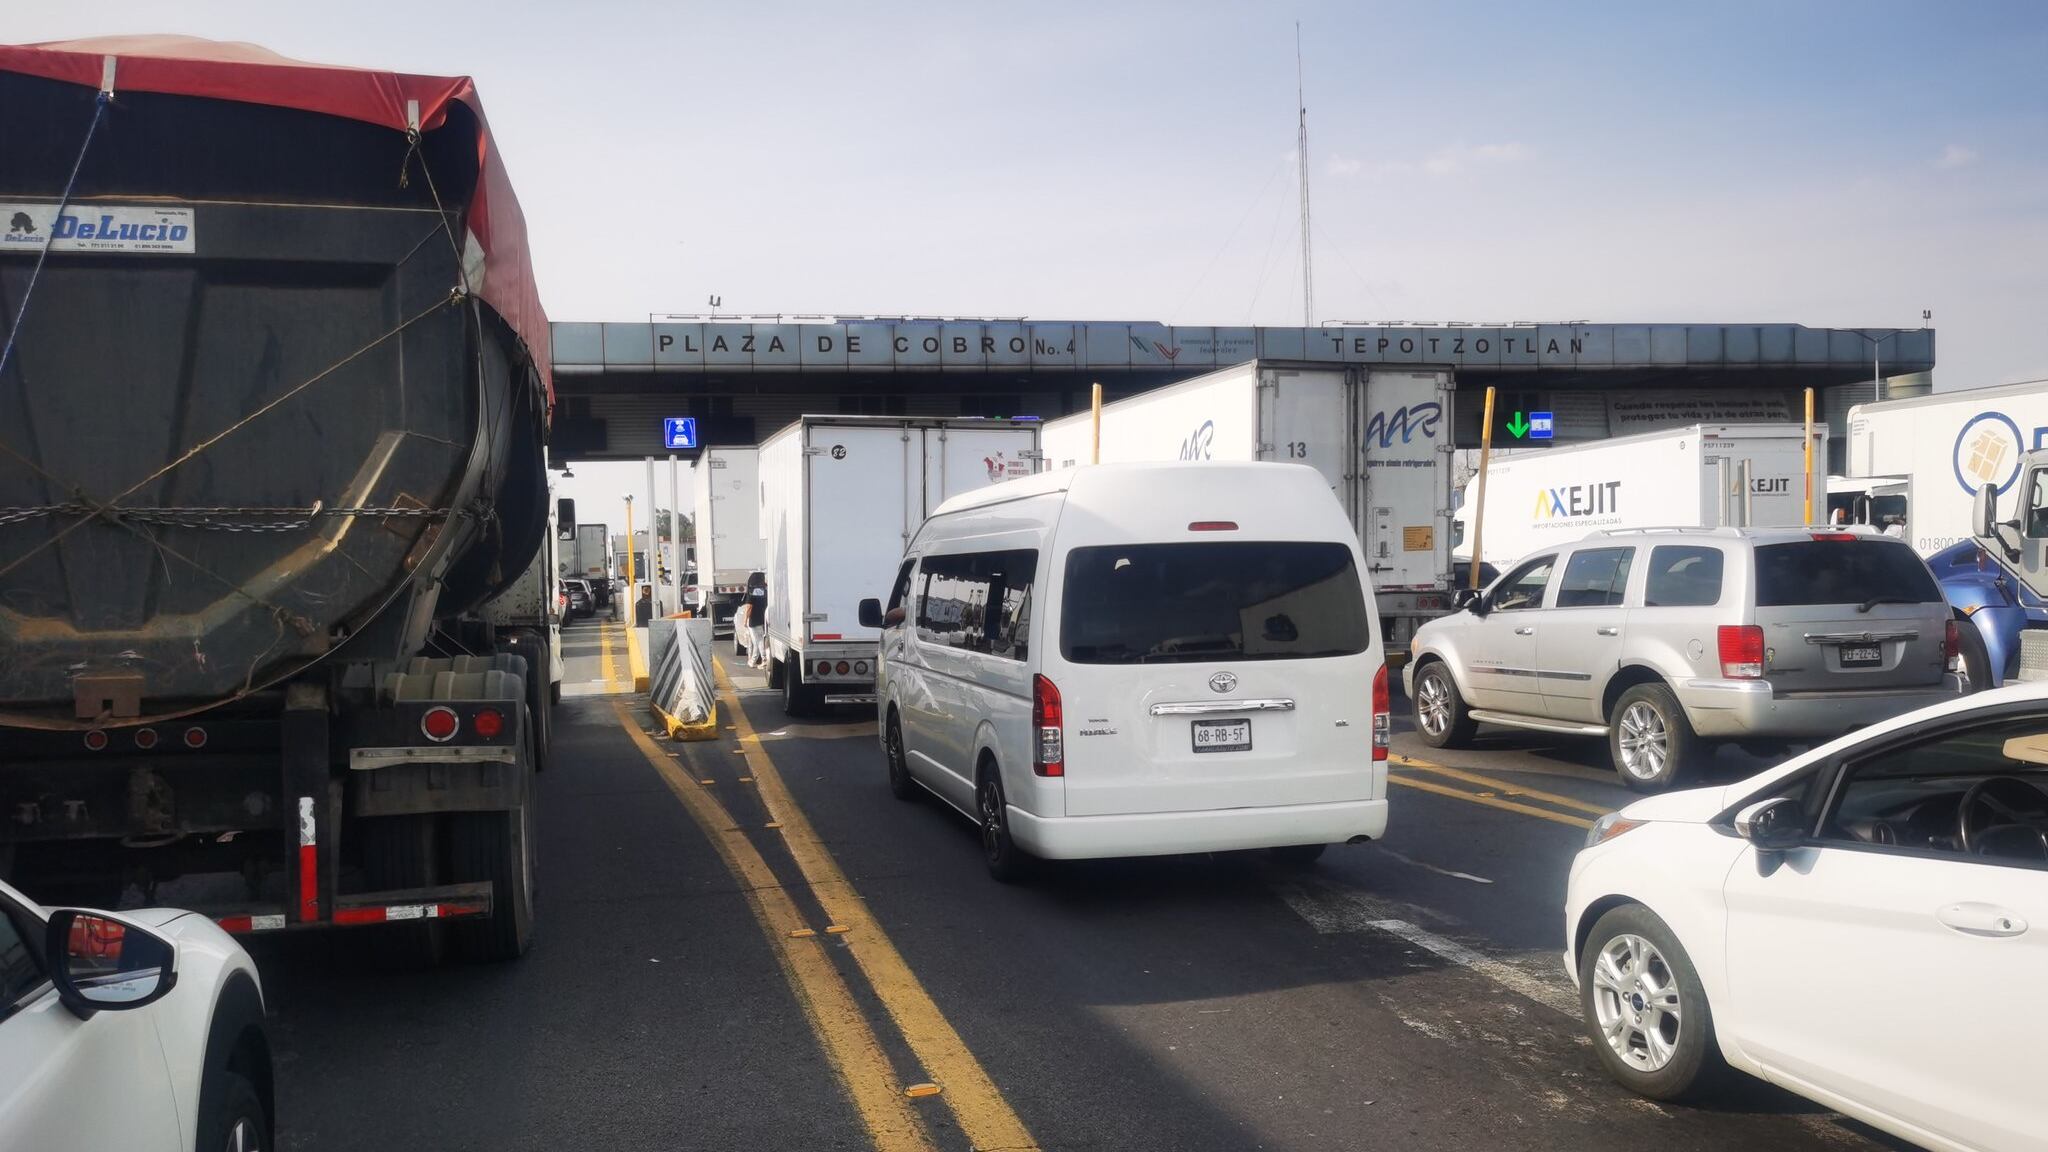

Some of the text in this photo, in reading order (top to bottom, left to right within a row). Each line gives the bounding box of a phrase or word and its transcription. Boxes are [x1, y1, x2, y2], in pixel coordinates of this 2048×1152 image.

[52, 214, 188, 241] DeLucio
[659, 335, 1075, 355] PLAZA DE COBRO No. 4
[1620, 412, 1666, 423] proteges
[1681, 411, 1703, 420] vida
[832, 446, 846, 458] 82
[1287, 441, 1307, 459] 13
[1533, 480, 1621, 520] AXEJIT
[1575, 518, 1622, 528] ESPECIALIZADAS
[1197, 727, 1245, 743] 68-RB-5F
